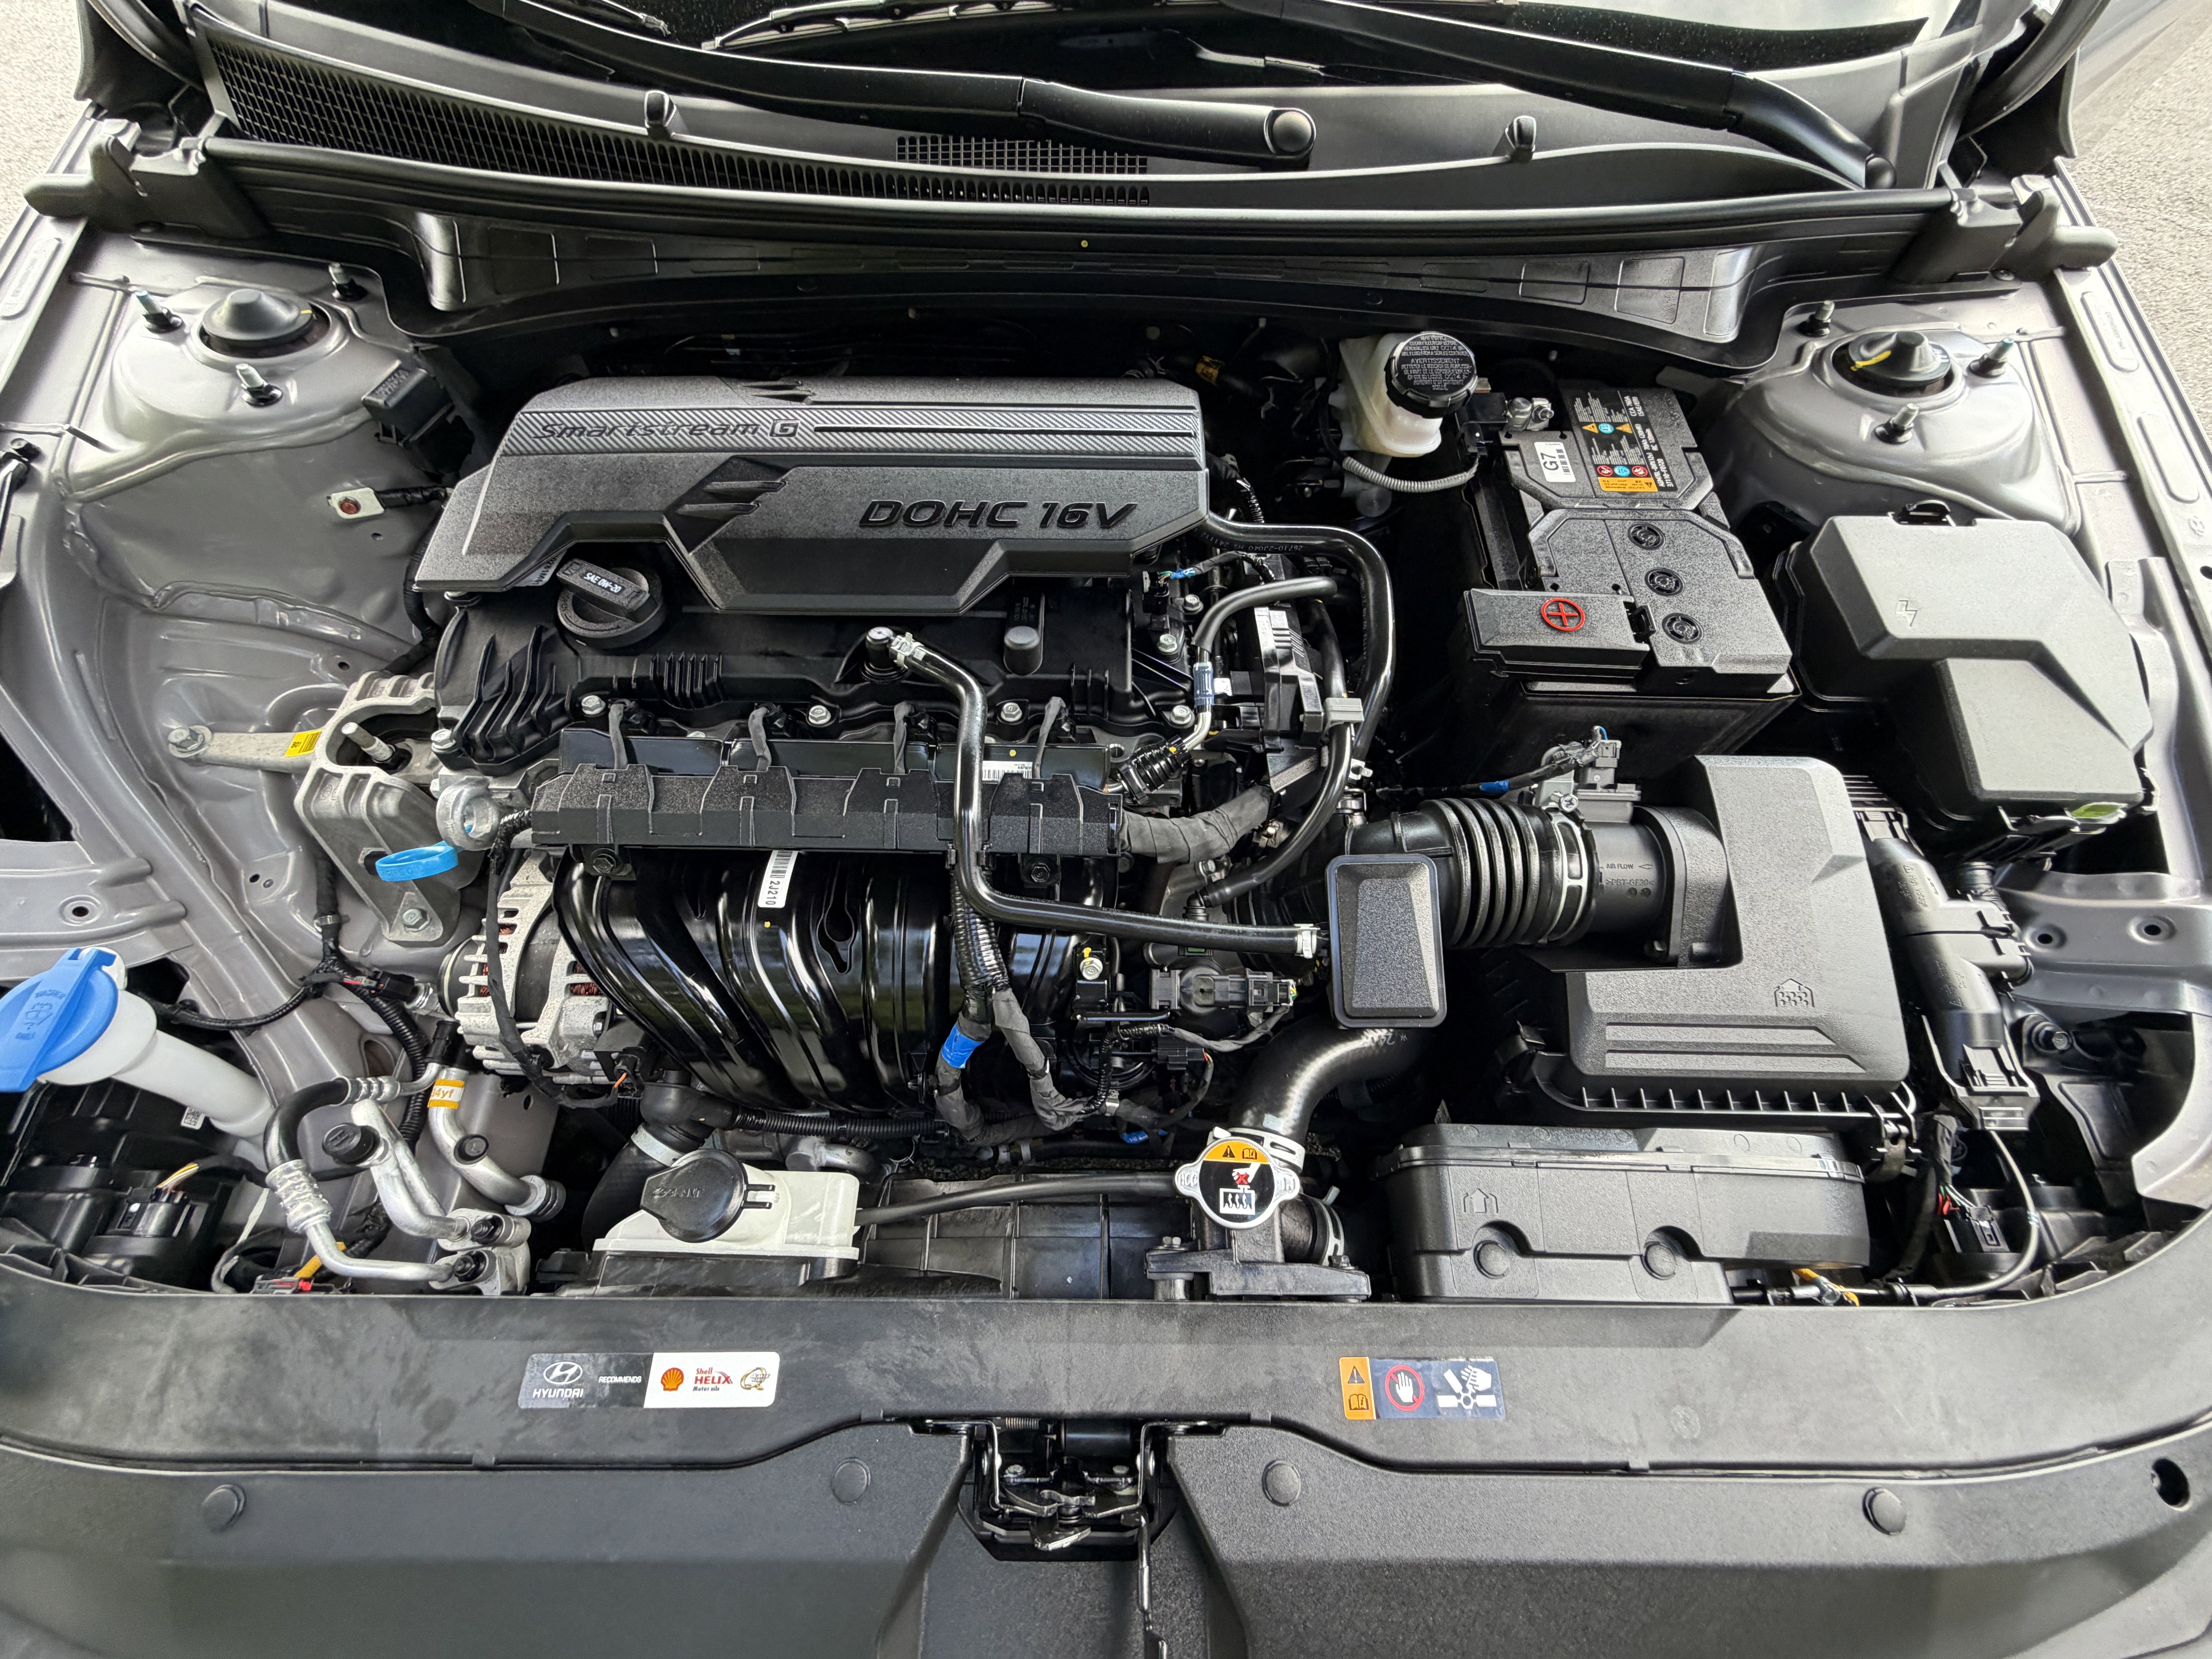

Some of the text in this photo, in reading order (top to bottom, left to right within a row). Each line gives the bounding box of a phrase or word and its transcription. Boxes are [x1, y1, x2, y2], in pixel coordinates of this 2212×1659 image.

[532, 421, 761, 440] Smartstream
[1540, 452, 1559, 470] G7
[859, 500, 1138, 529] DOHC 16V
[583, 572, 622, 593] SAE 0W-20
[765, 880, 780, 905] 2J210
[532, 1388, 584, 1399] HYUNDAI
[598, 1376, 642, 1384] RECOMMENDS
[694, 1371, 733, 1384] HELIX
